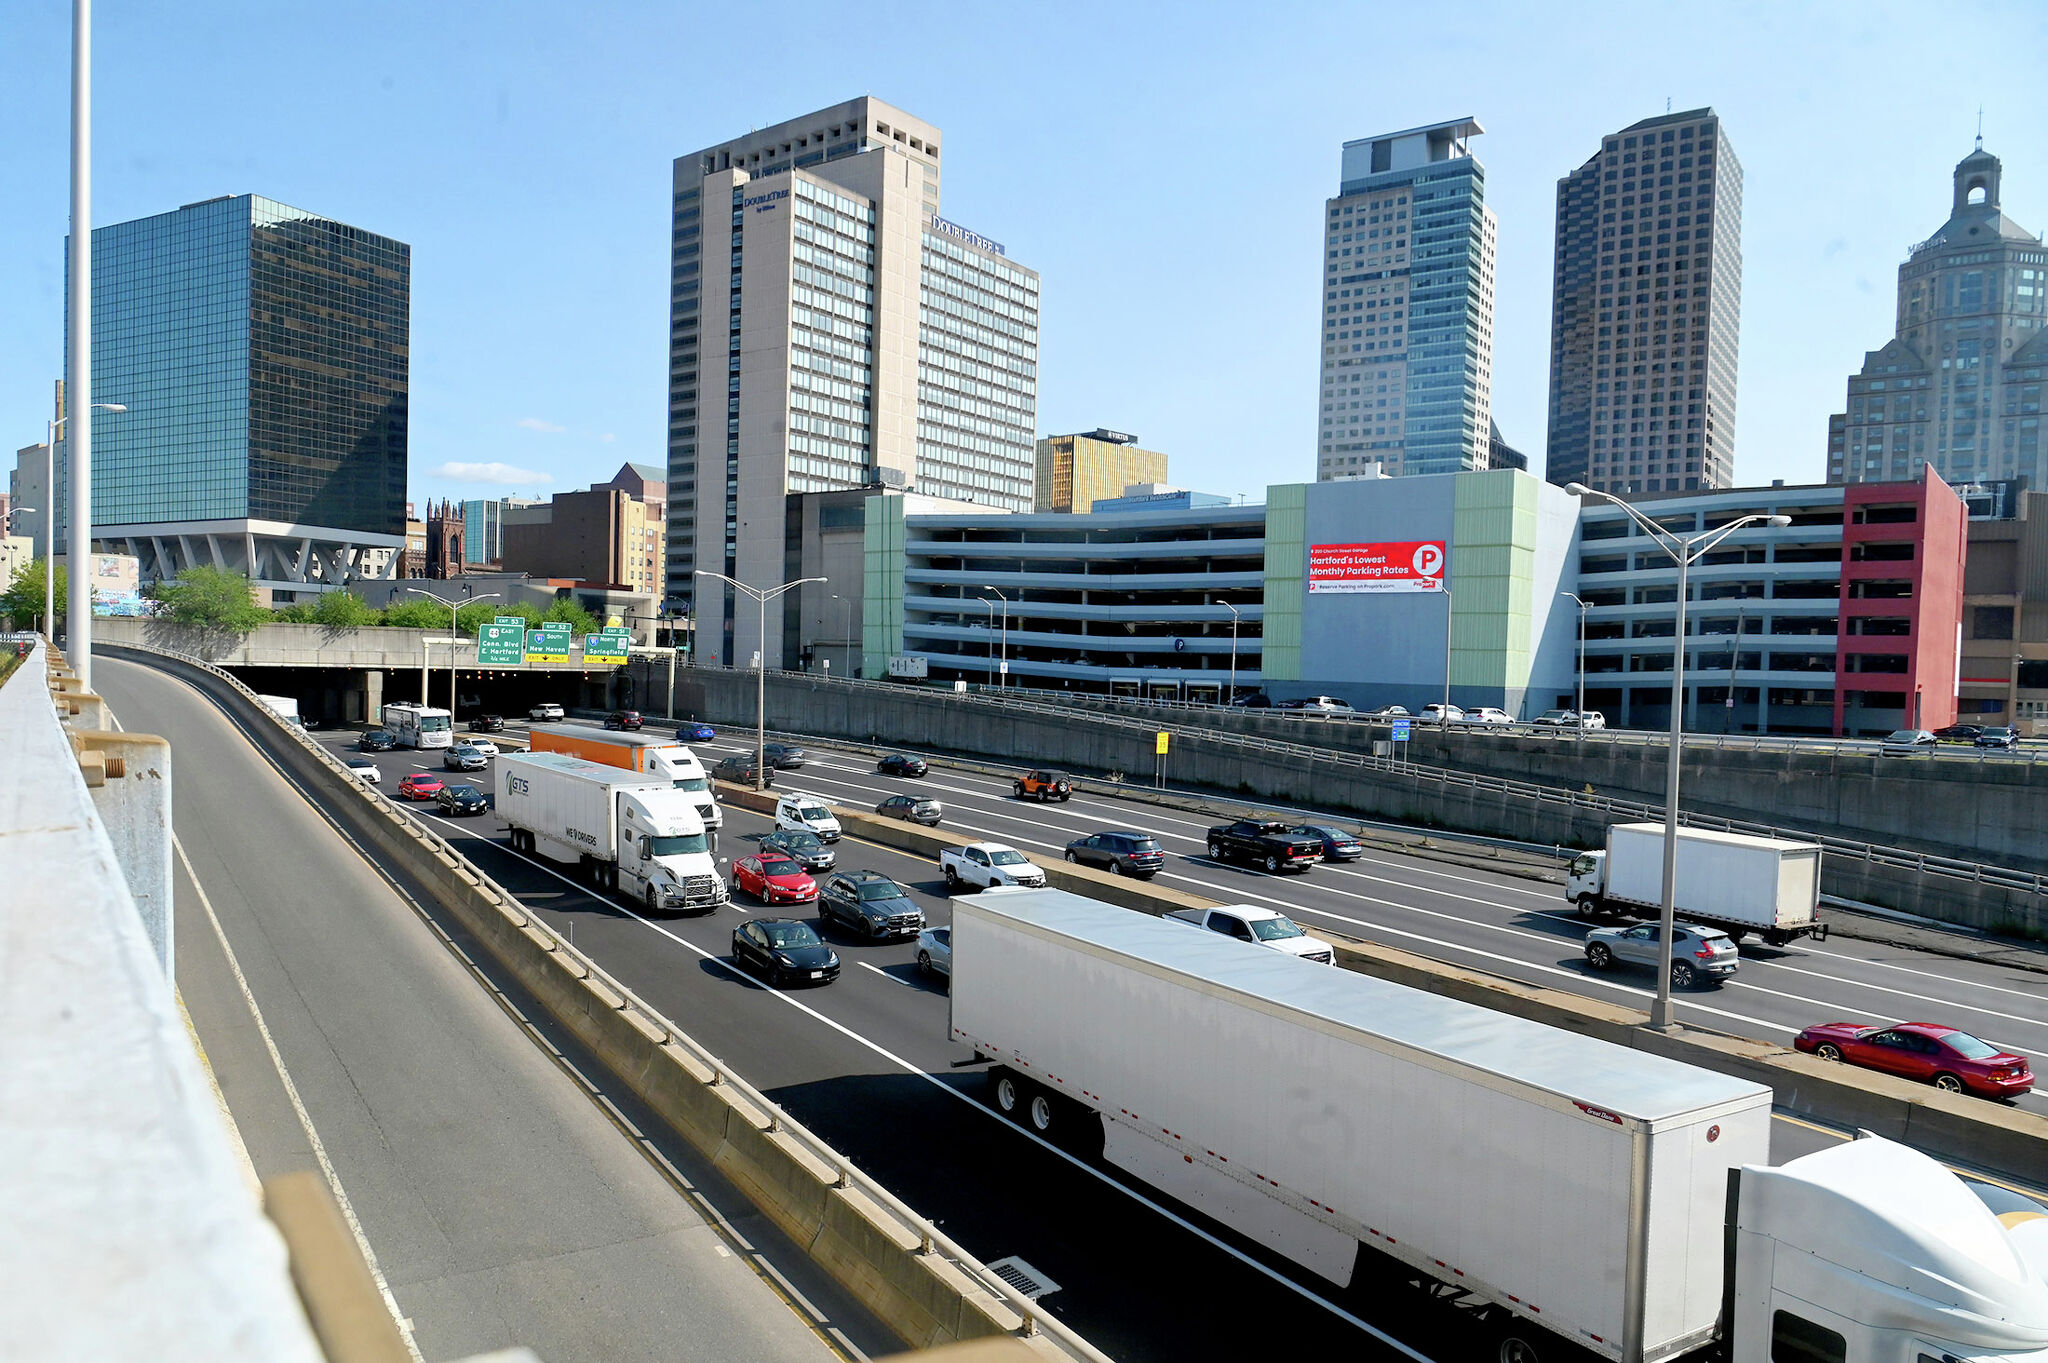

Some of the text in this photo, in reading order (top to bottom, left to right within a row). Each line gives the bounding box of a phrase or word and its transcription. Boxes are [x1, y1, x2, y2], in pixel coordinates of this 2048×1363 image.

[745, 189, 789, 207] DOUBLETREE
[932, 215, 994, 253] DOUBLETREE
[1310, 555, 1386, 565] Hartford's Lowest
[1310, 565, 1409, 577] Monthly Parking Rates
[589, 648, 624, 656] Springfield
[513, 777, 528, 793] GTS
[565, 826, 597, 847] WE DRIVERS
[1587, 1107, 1615, 1121] Great Dane
